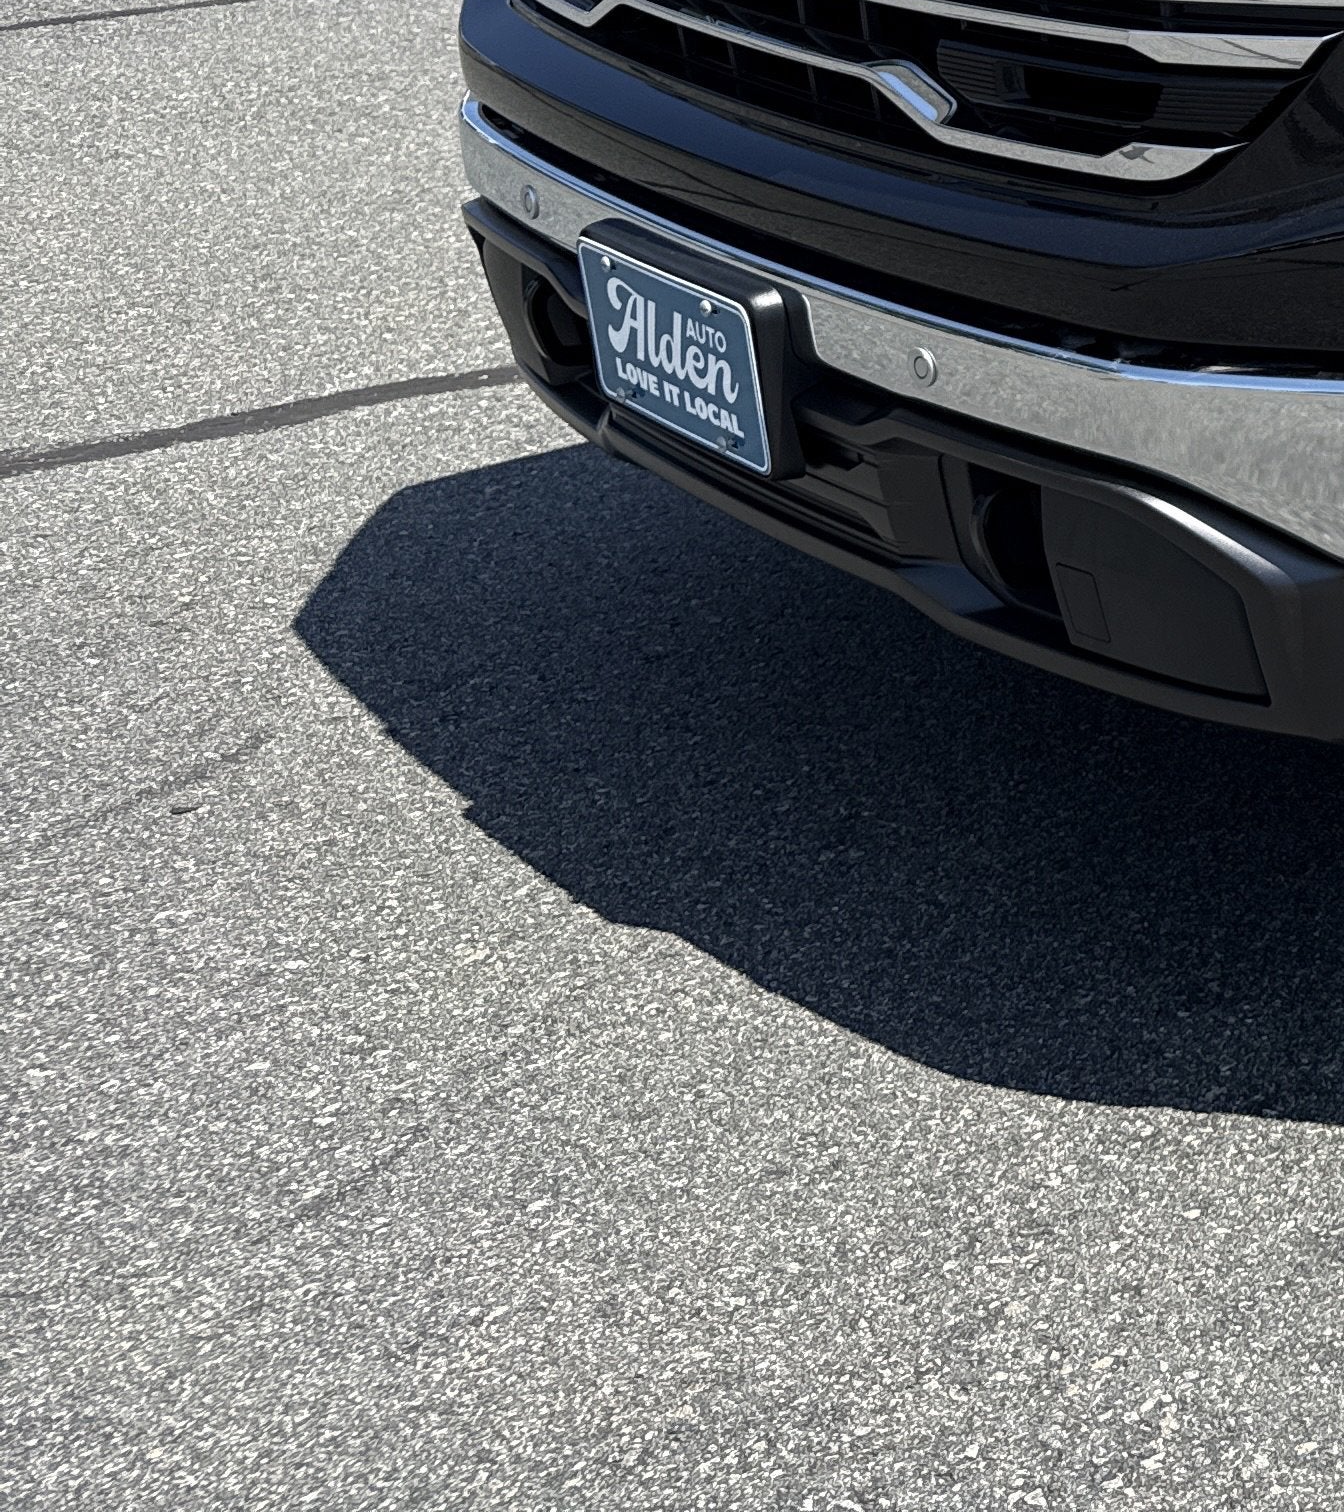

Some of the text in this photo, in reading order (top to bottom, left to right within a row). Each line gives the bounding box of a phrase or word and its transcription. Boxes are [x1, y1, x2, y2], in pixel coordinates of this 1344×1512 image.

[606, 276, 740, 404] Alden
[685, 318, 727, 354] AUTO
[616, 357, 745, 439] LOVE IT LOCAL
